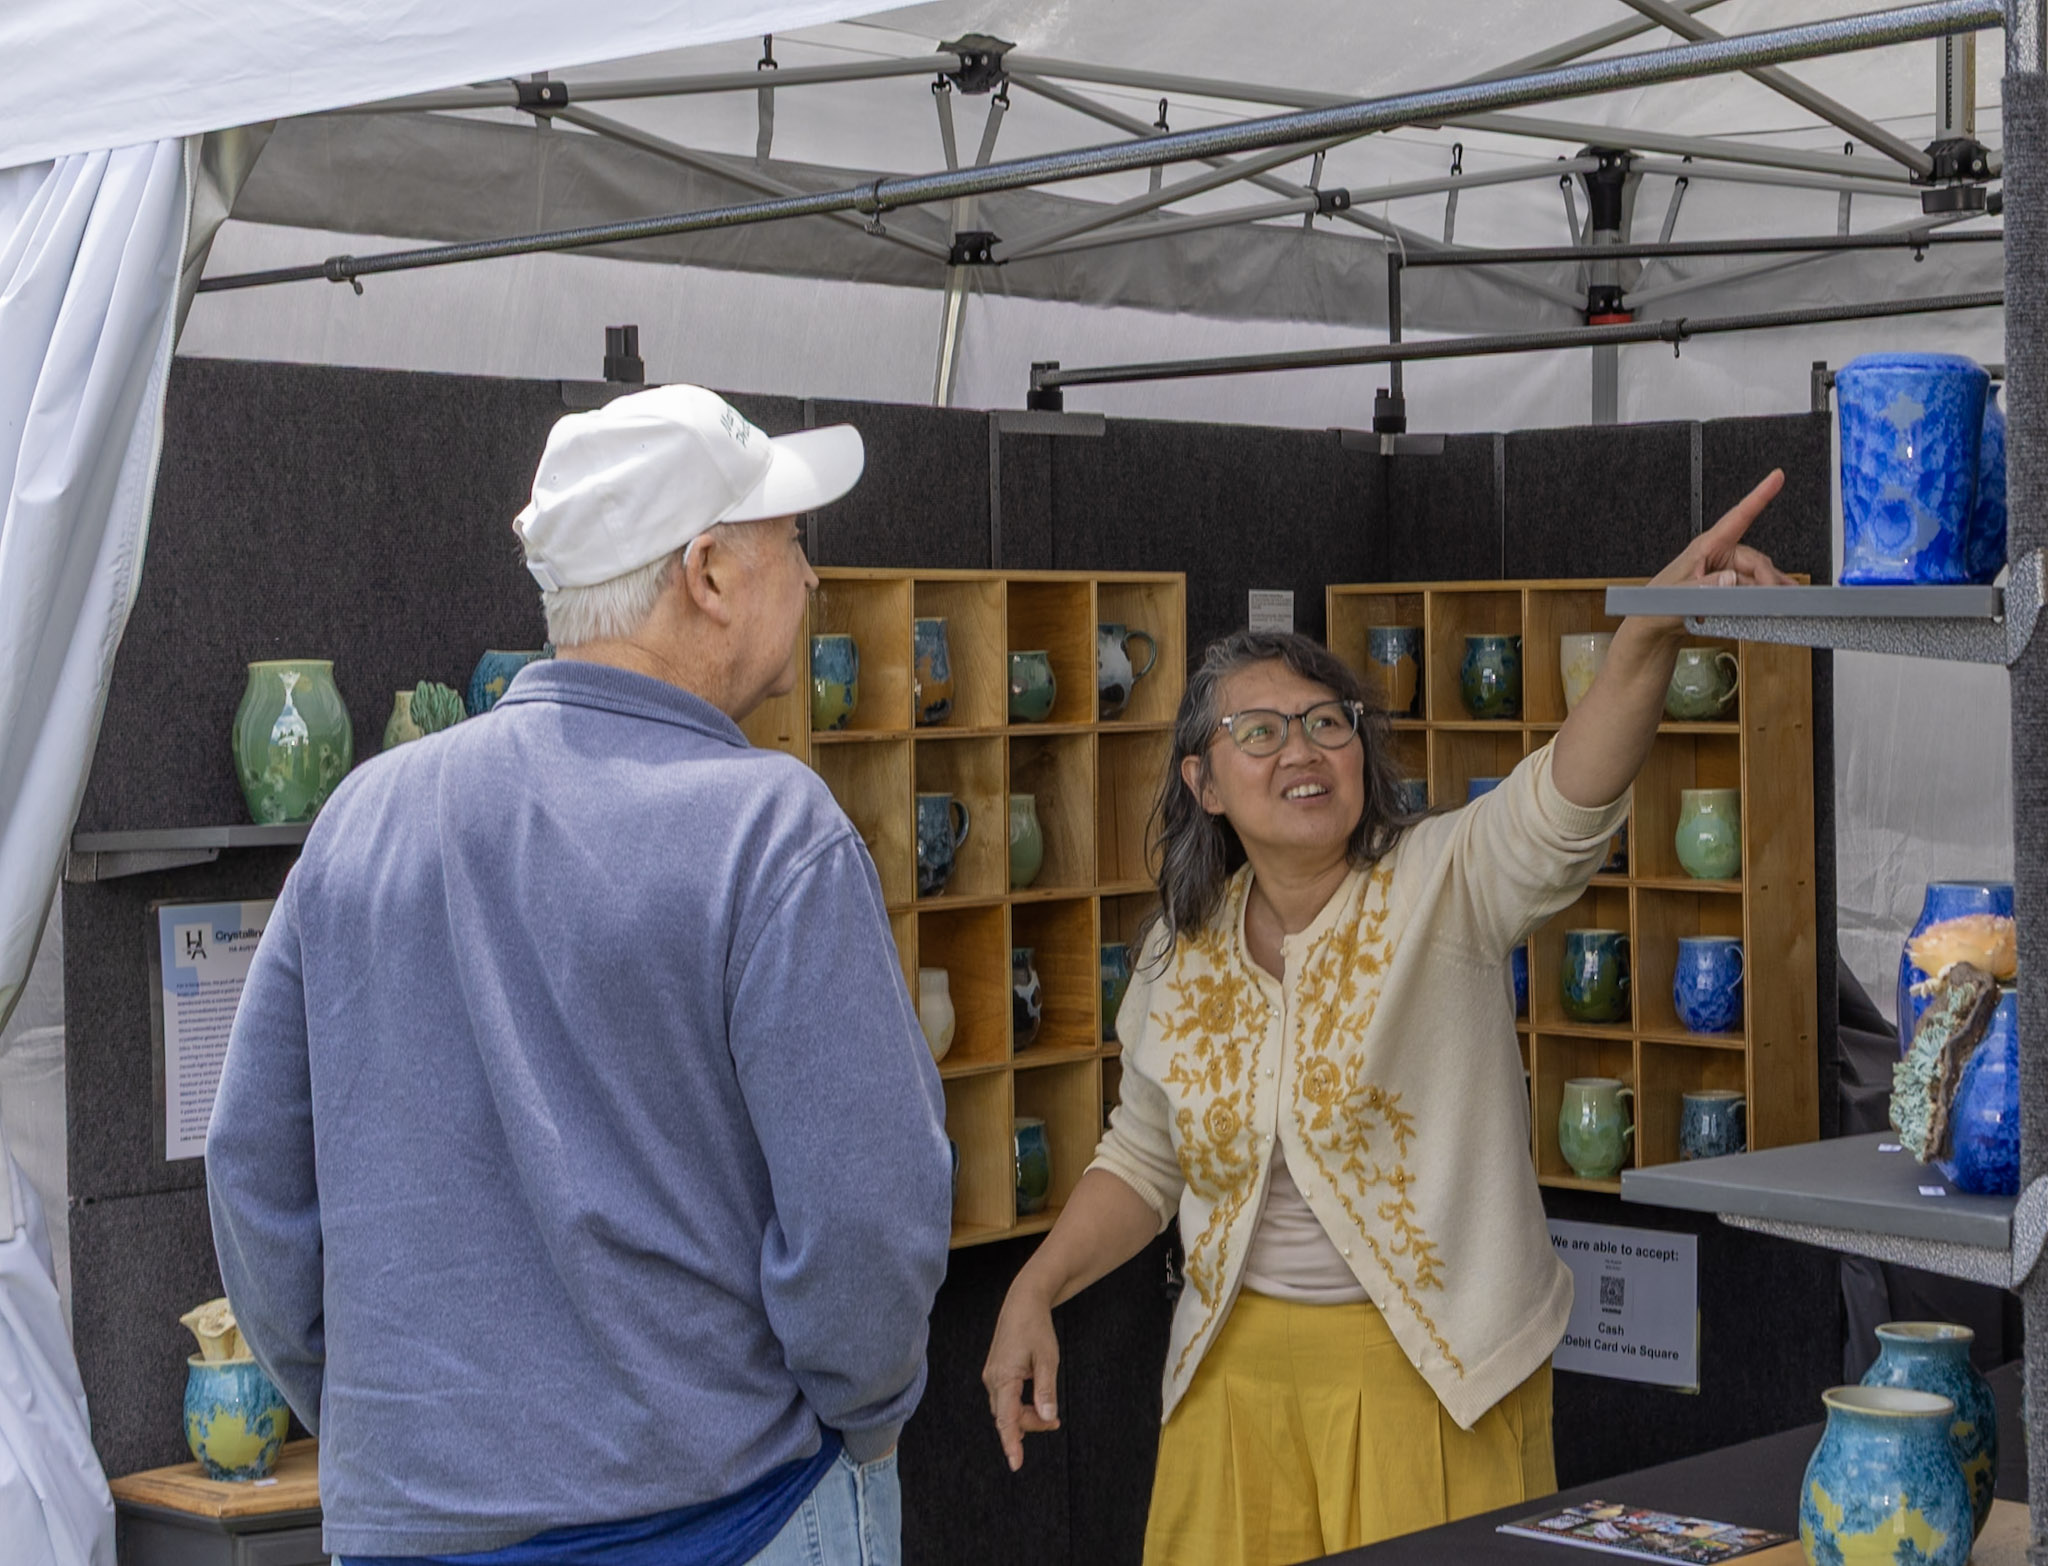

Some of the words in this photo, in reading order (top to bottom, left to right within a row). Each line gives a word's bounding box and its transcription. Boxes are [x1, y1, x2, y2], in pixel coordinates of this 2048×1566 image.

[1551, 1234, 1569, 1249] We
[1572, 1240, 1590, 1252] are
[1593, 1241, 1617, 1255] able
[1621, 1244, 1633, 1256] to
[1635, 1247, 1680, 1262] accept:
[1597, 1321, 1625, 1337] Cash
[1593, 1338, 1619, 1353] Card
[1620, 1343, 1637, 1356] via
[1639, 1344, 1680, 1361] Square
